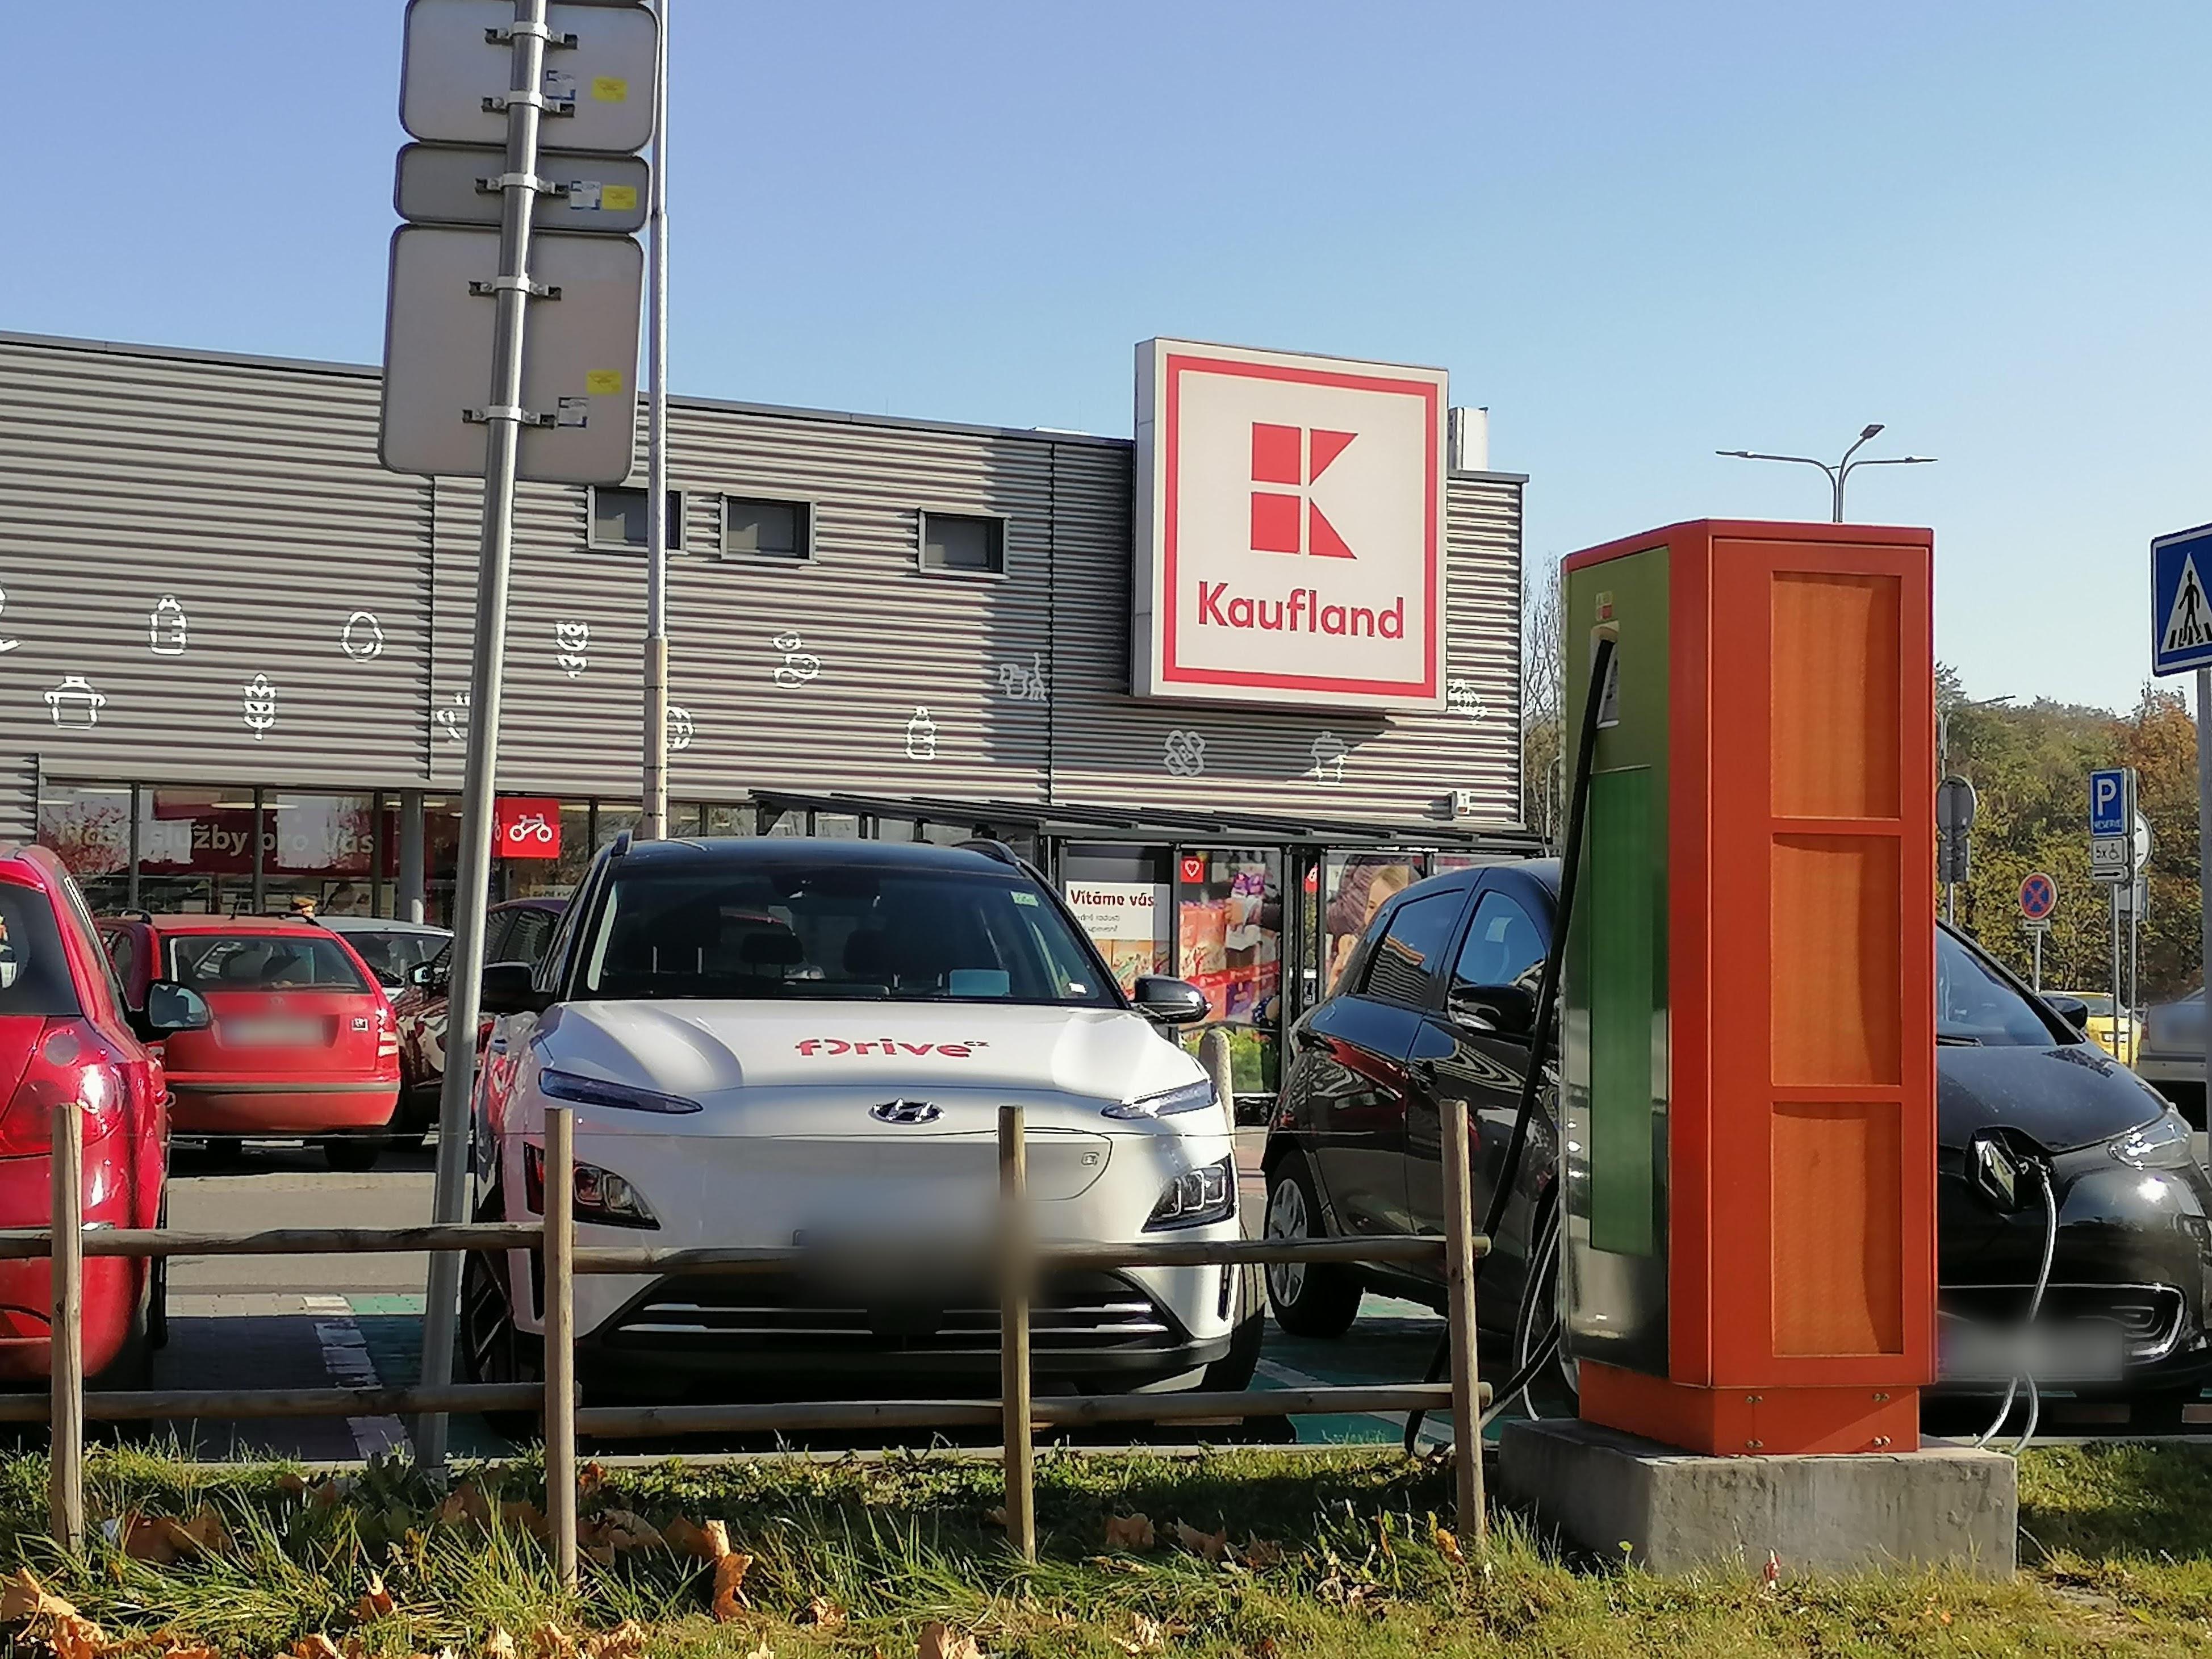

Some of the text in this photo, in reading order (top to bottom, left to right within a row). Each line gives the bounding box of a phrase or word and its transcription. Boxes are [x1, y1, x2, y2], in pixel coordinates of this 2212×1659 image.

[1198, 580, 1404, 640] Kaufland
[2097, 778, 2117, 817] P
[150, 818, 248, 856] služby
[1071, 889, 1125, 906] Vítáme
